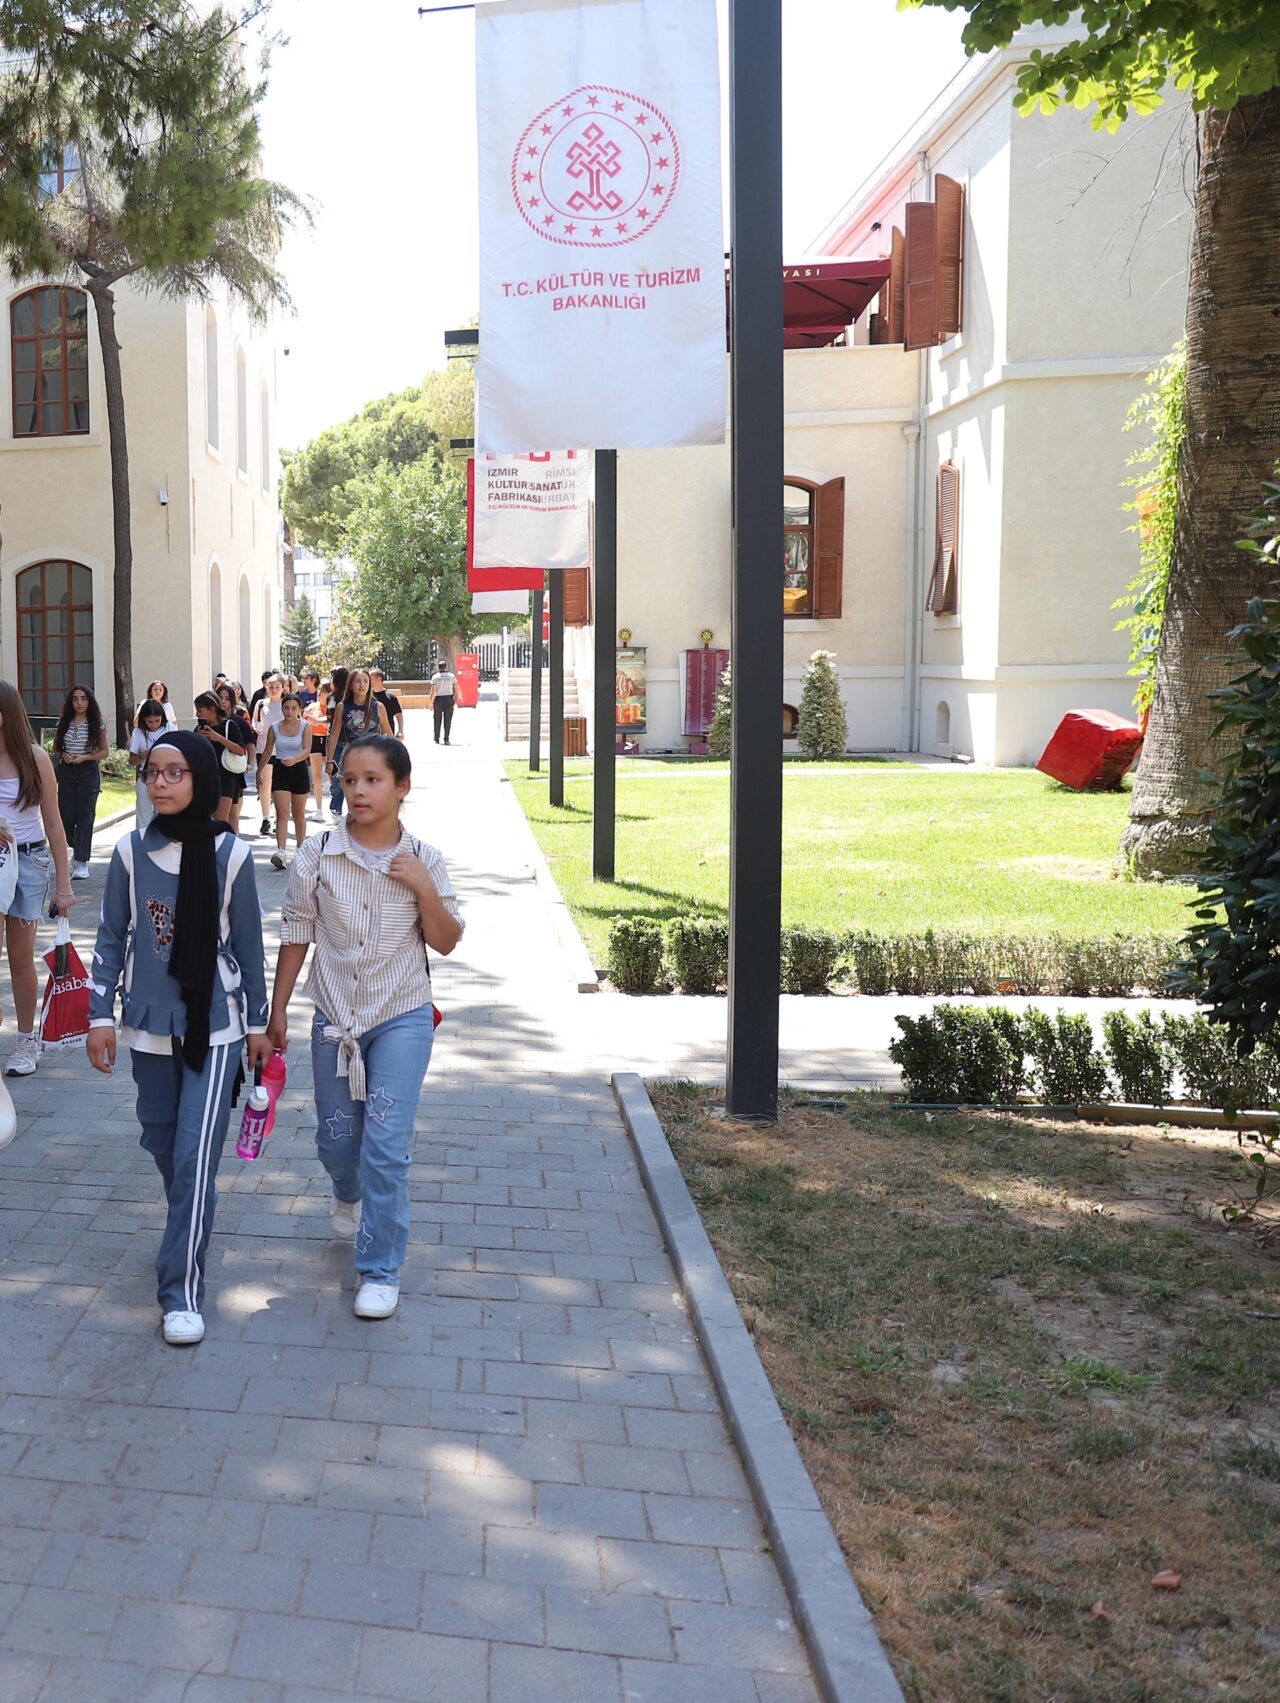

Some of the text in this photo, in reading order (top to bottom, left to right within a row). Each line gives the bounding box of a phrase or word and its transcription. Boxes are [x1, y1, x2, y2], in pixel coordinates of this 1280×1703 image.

[502, 266, 701, 298] T.C. KÜLTÜR VE TURİZM
[553, 292, 646, 311] BAKANLIĞI
[487, 466, 519, 477] İZMİR
[488, 478, 528, 489] KÜLTÜR
[529, 481, 562, 491] SANAT
[488, 491, 541, 503] FABRİKASI
